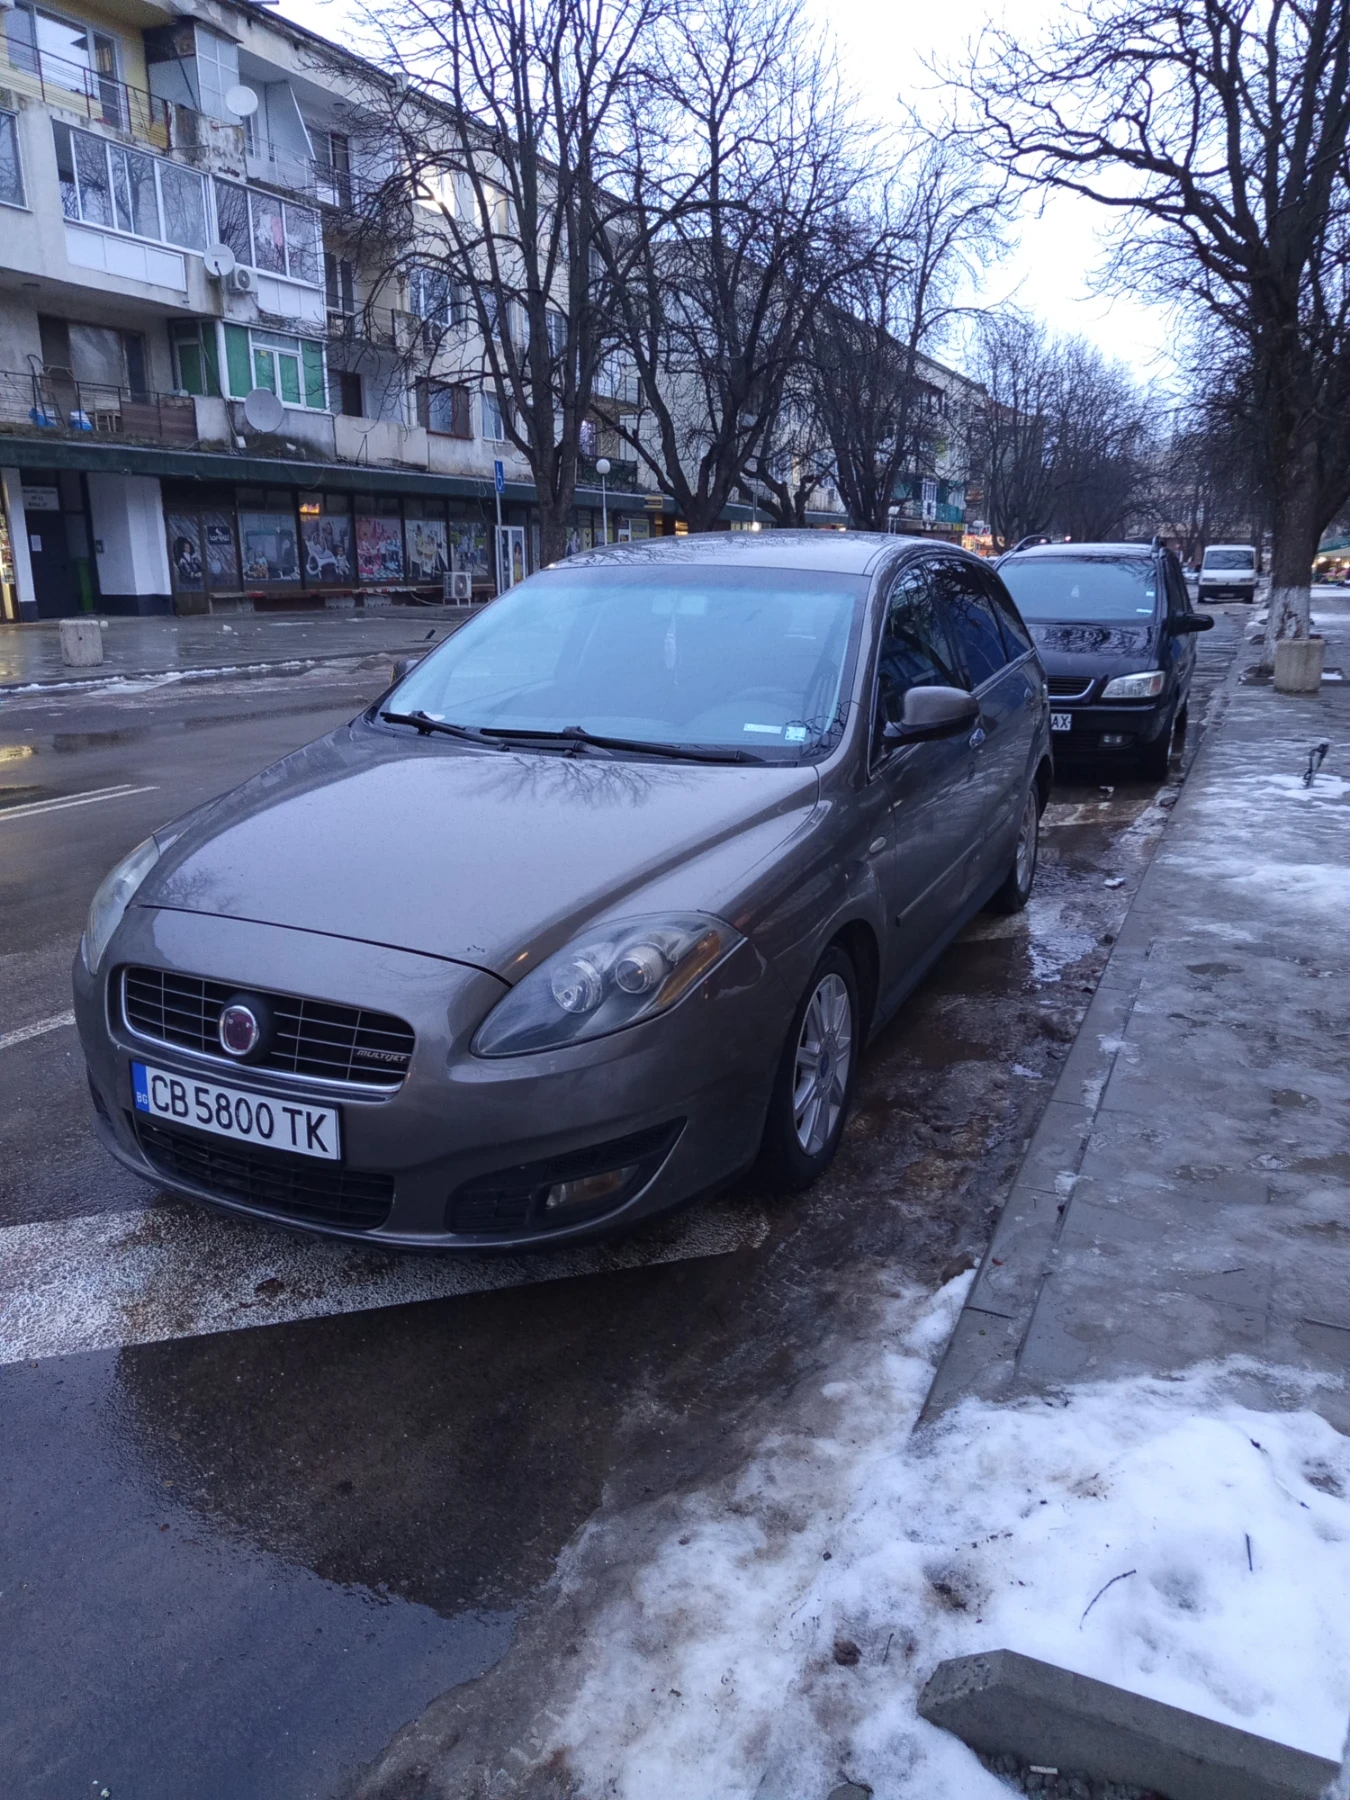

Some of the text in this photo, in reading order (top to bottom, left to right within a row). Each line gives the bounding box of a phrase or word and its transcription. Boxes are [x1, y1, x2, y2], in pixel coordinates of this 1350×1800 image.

[356, 1050, 407, 1062] MULTIJET
[136, 1091, 148, 1105] BG
[151, 1074, 330, 1153] CB 5800 TK
